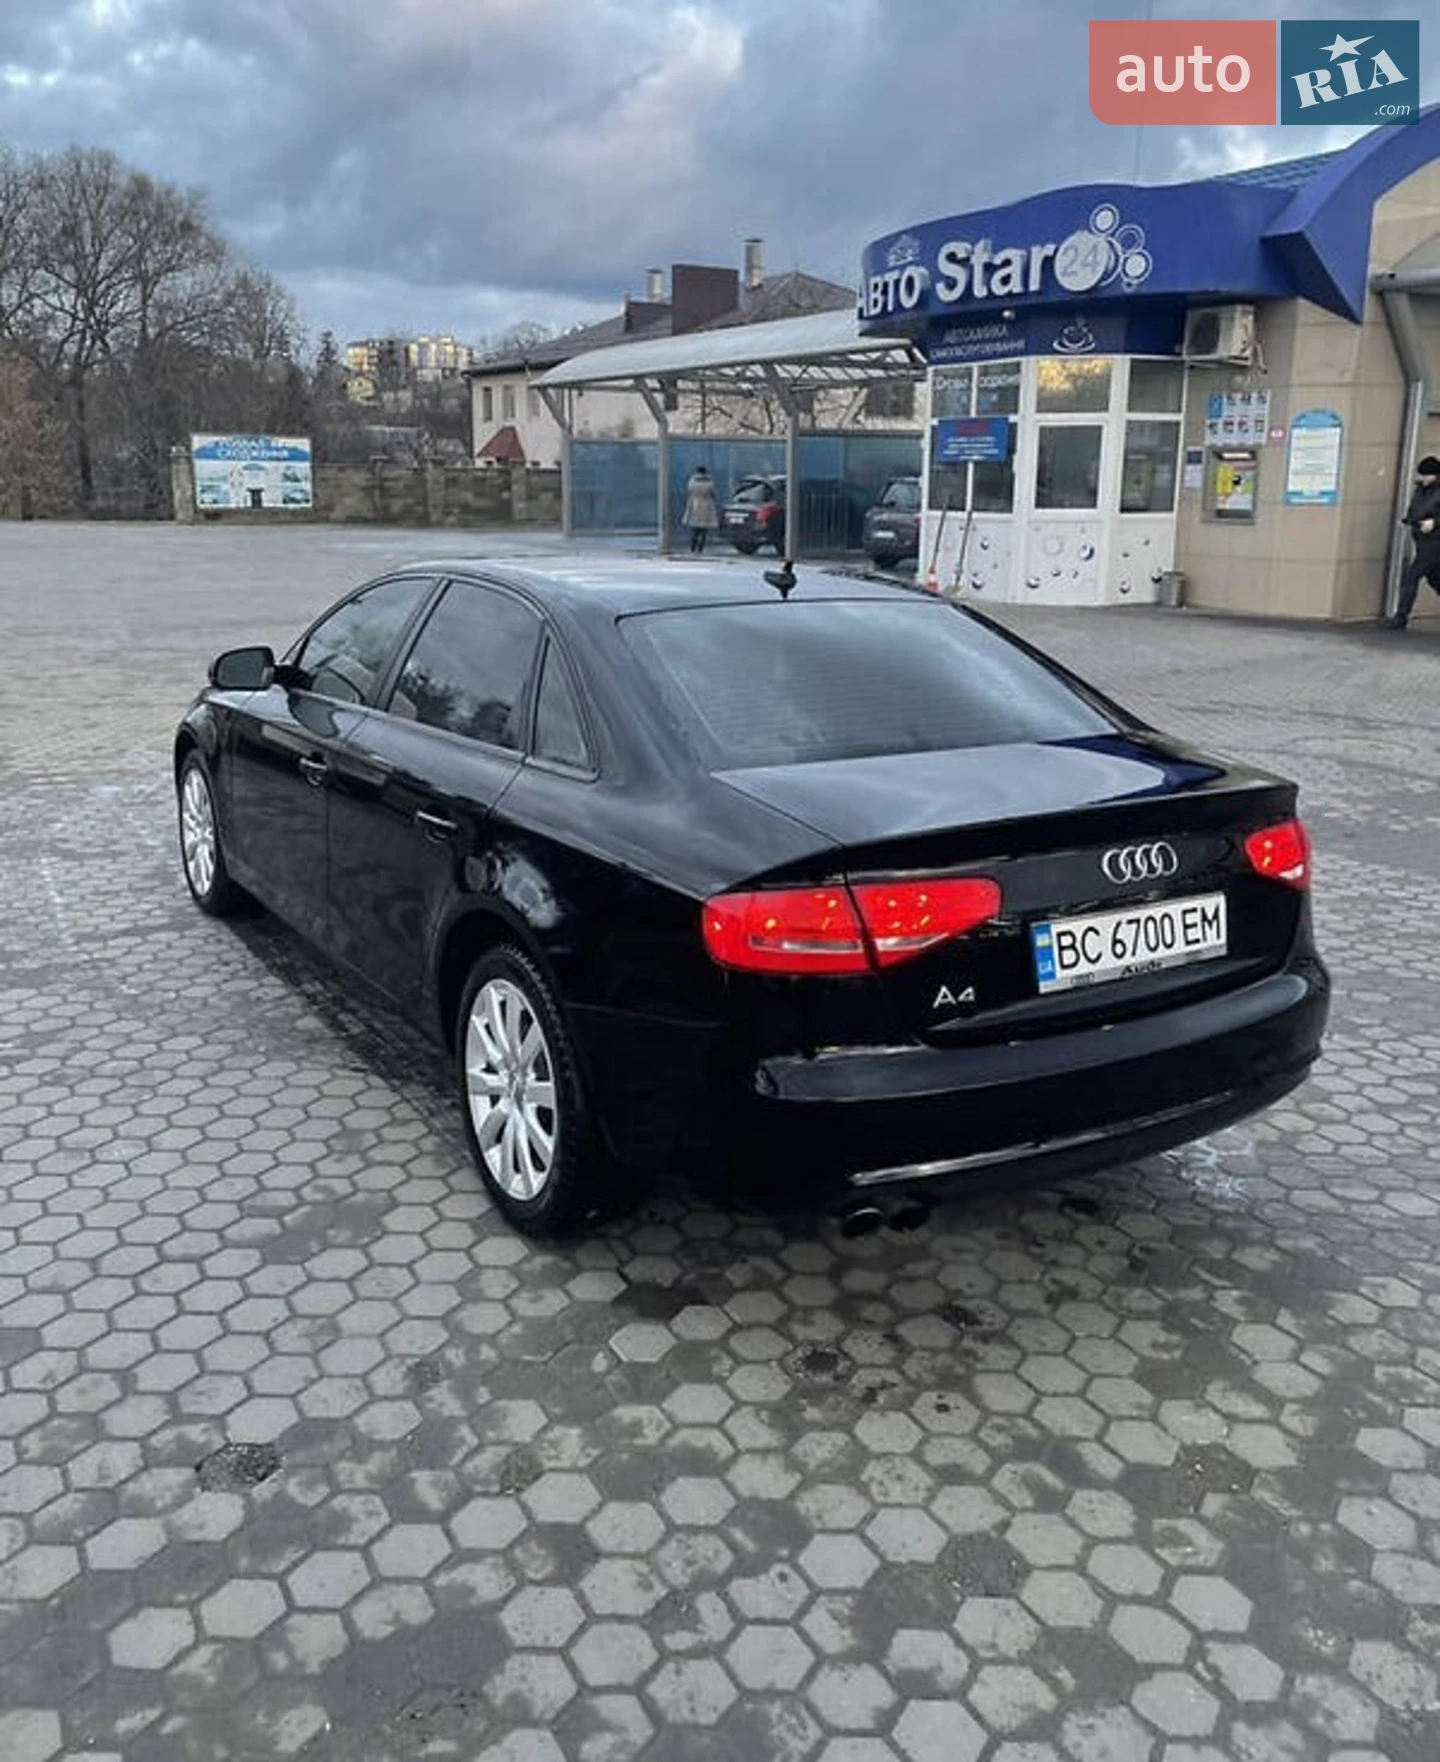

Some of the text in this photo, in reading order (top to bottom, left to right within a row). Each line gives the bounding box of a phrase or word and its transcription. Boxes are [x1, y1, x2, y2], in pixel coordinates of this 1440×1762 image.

[935, 238, 1057, 303] Star
[1061, 243, 1100, 277] 24
[1056, 904, 1221, 970] BC 6700 EM
[932, 984, 976, 1009] A4
